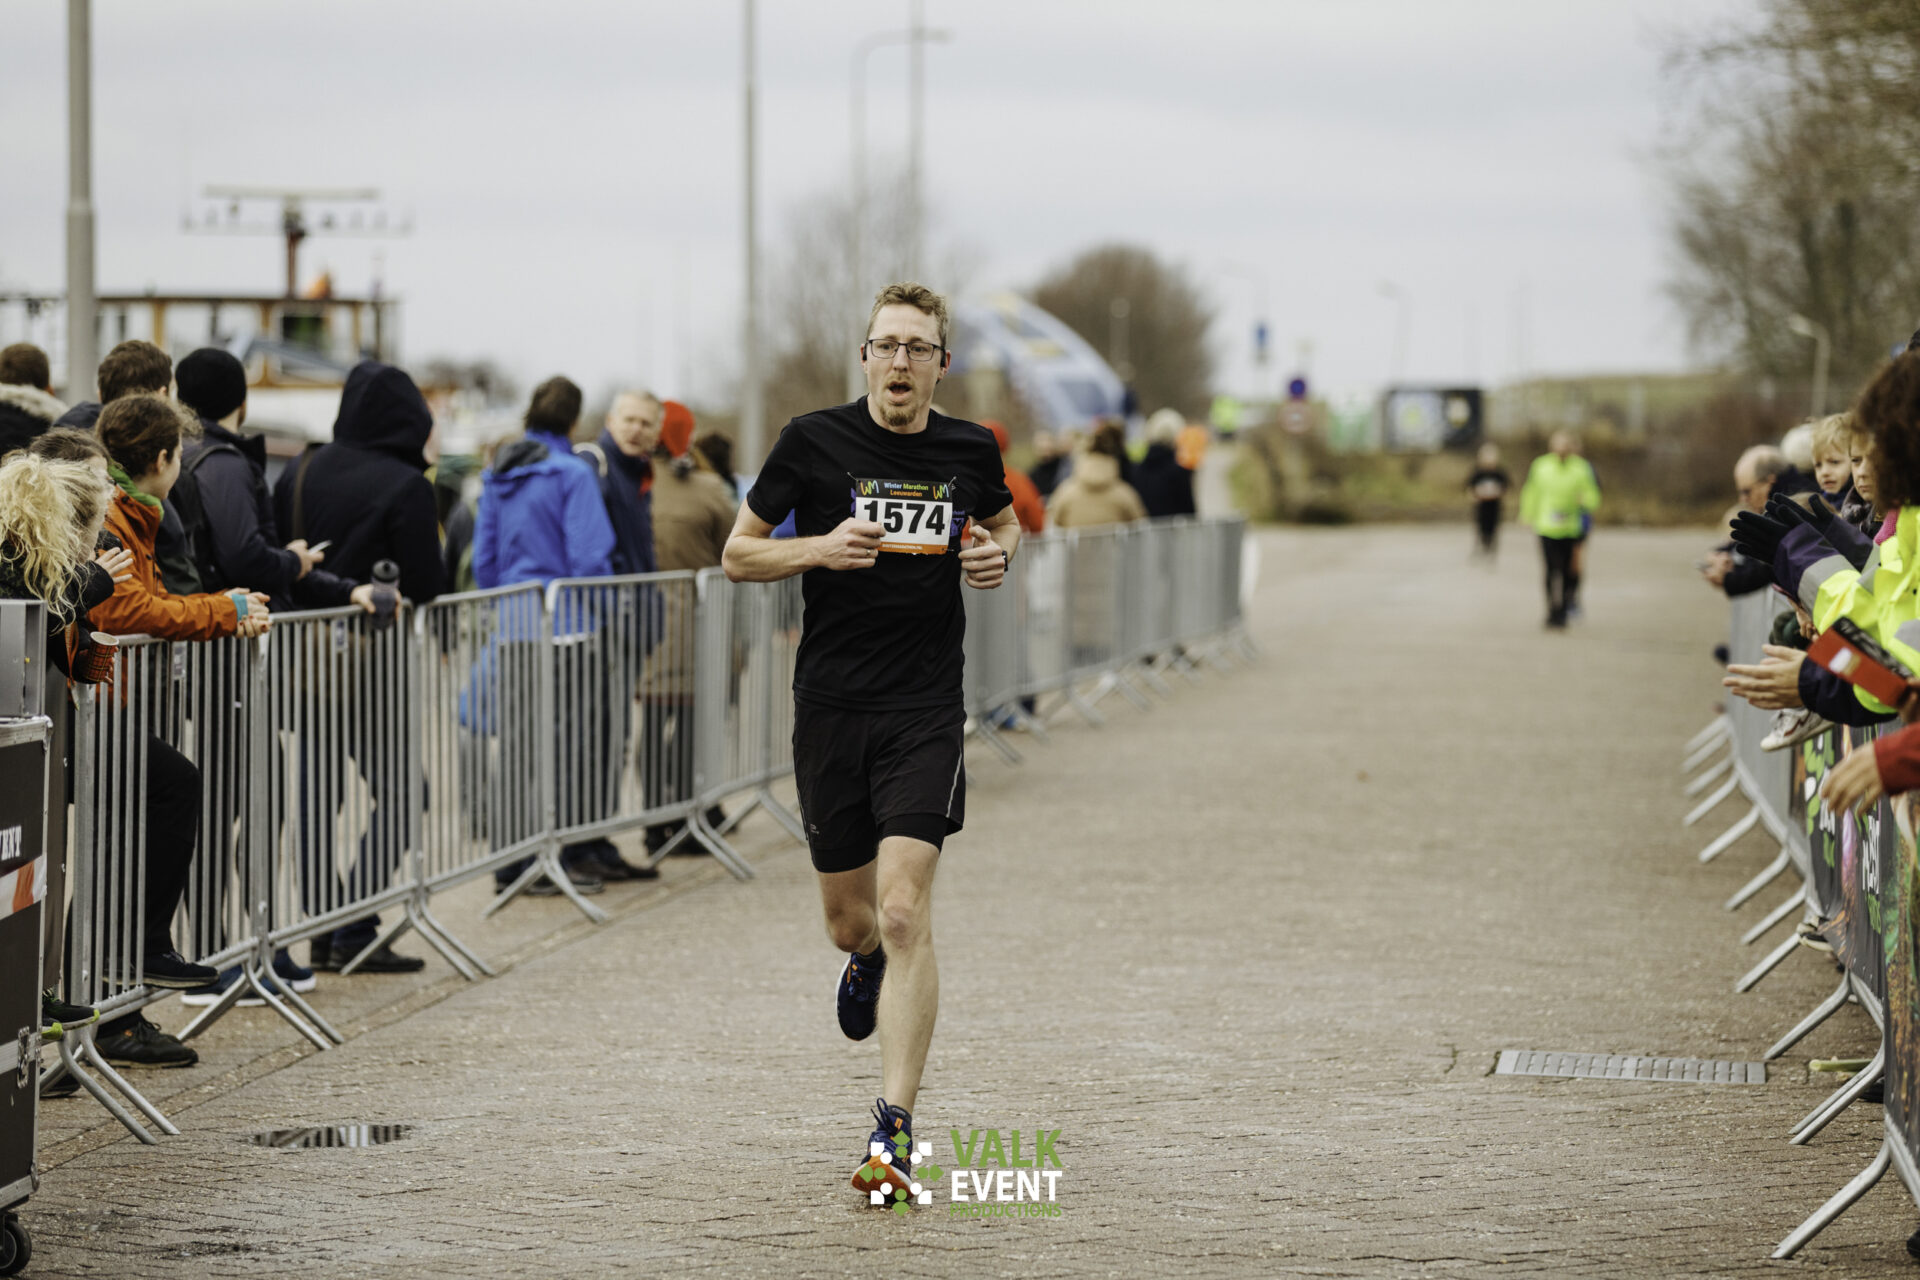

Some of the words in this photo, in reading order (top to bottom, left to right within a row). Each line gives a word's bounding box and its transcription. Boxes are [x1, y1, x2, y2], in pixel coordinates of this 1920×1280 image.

[889, 489, 923, 497] Leeuwarden
[903, 483, 929, 491] Marathon
[864, 500, 945, 535] 1574
[0, 825, 22, 861] ENT
